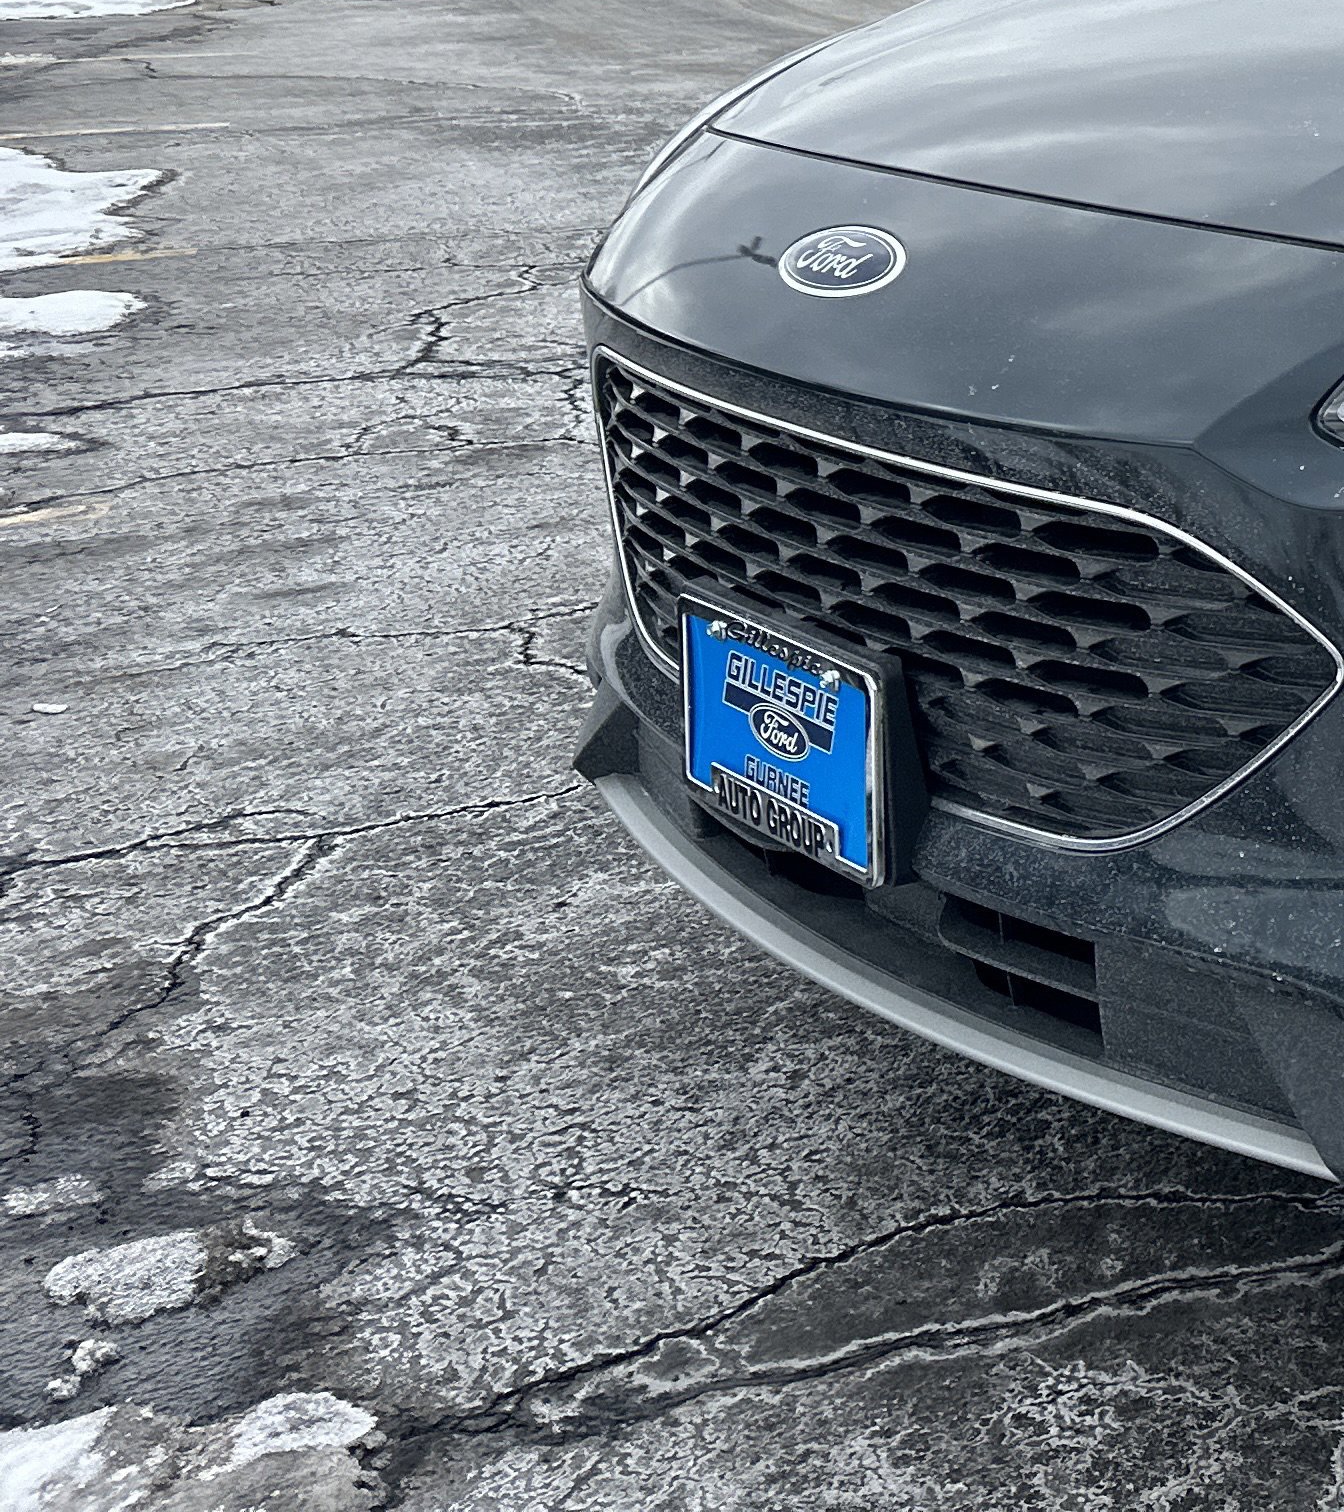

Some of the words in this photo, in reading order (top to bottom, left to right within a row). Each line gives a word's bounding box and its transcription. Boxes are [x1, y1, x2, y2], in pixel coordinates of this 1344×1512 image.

[796, 235, 874, 279] Ford
[726, 650, 840, 728] GILLESPIE
[760, 711, 799, 753] Ford
[744, 754, 810, 809] GURNEE
[718, 773, 763, 826] AUTO
[766, 797, 827, 858] GROUP
